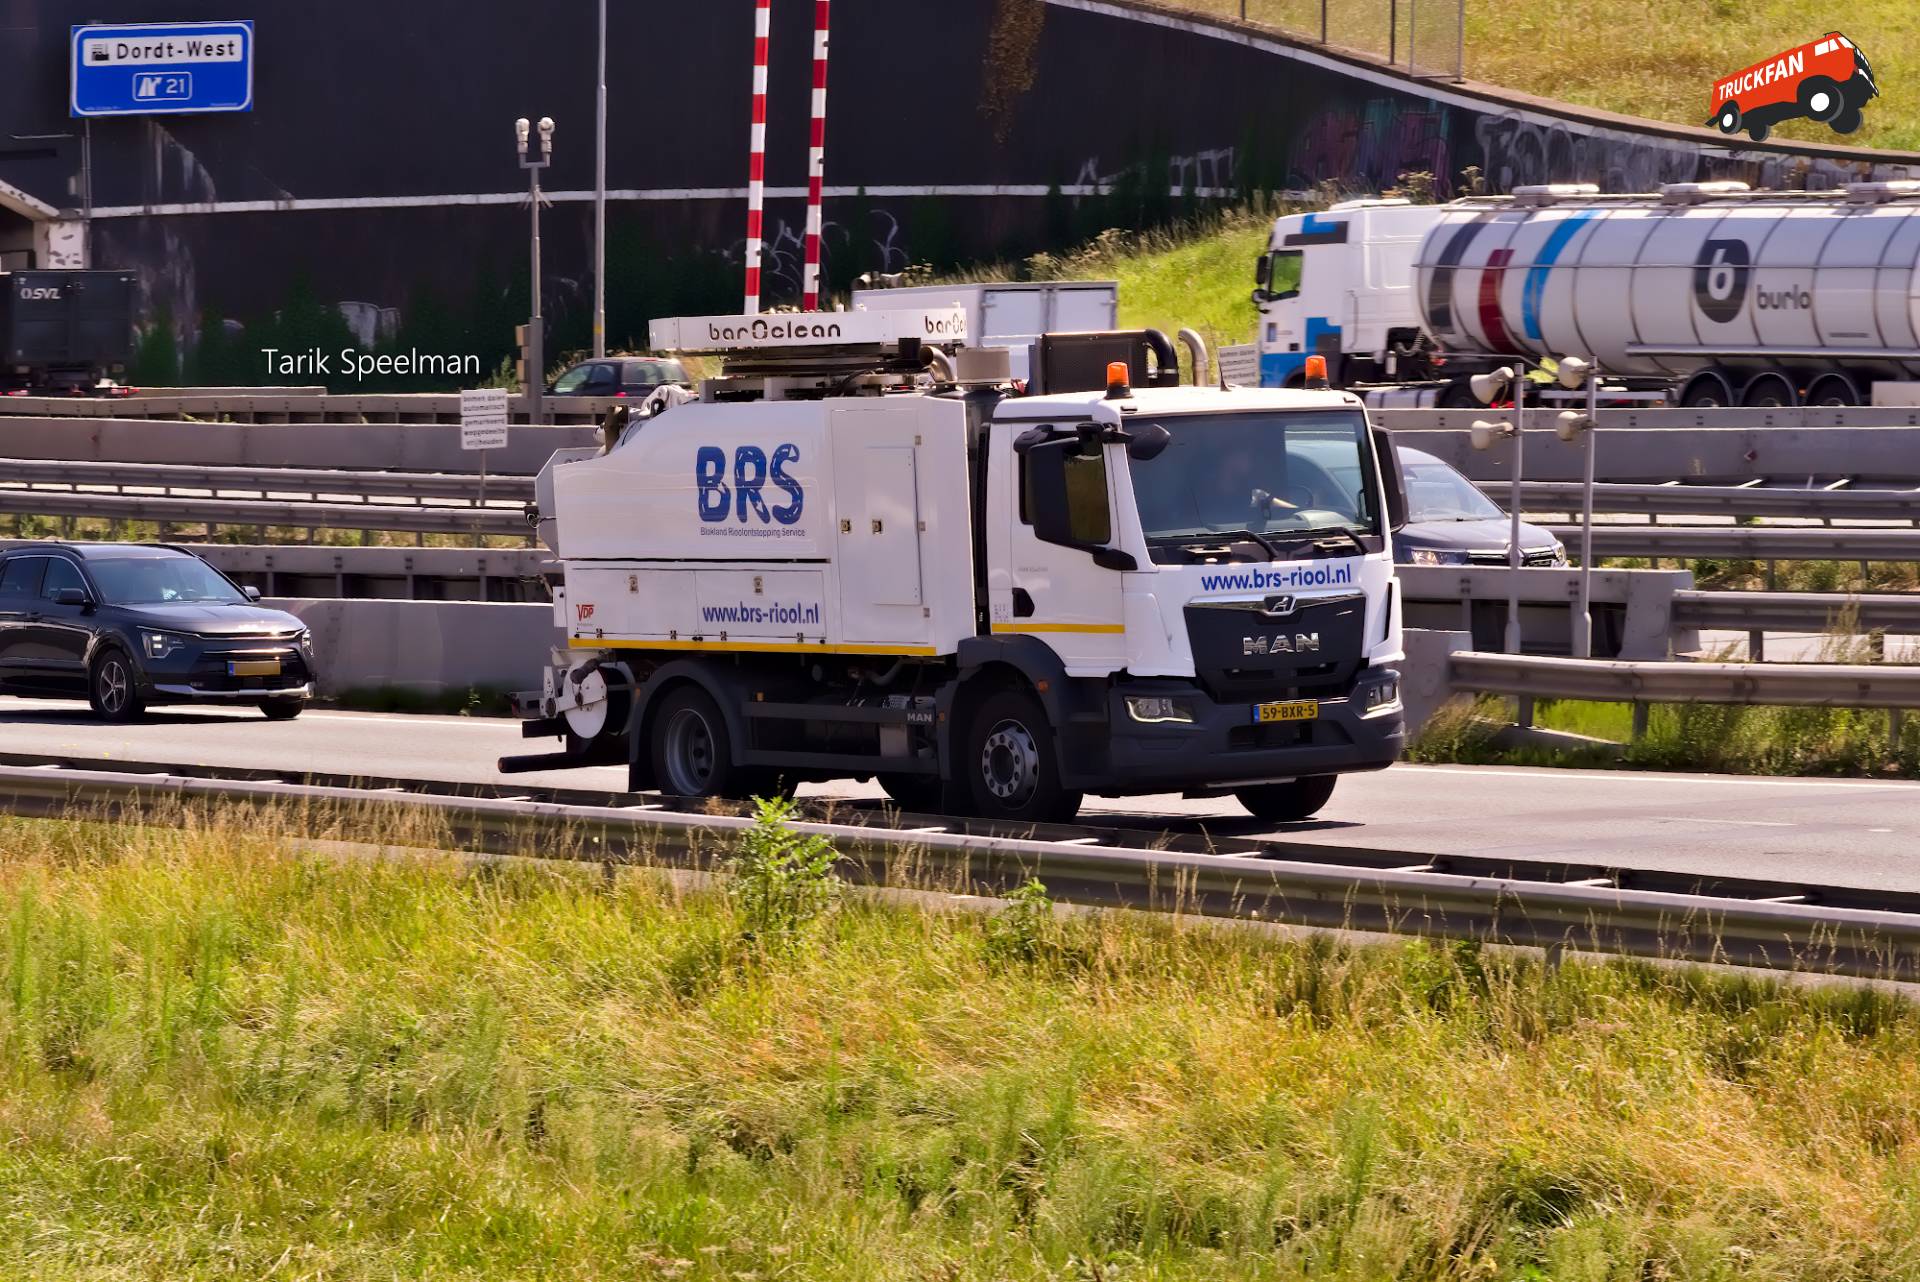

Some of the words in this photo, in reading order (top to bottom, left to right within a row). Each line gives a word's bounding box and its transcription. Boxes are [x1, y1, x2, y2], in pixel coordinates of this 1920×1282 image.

[116, 40, 236, 60] Dordt-West
[165, 78, 185, 94] 21
[1756, 284, 1812, 310] burlo
[696, 443, 804, 525] BRS
[781, 527, 806, 537] Service
[1201, 563, 1352, 591] www.brs-riool.nl
[576, 604, 595, 622] VDP
[702, 601, 819, 625] www.brs-riool.nl
[1243, 632, 1320, 656] MAN
[907, 712, 933, 722] MAN
[1262, 704, 1315, 720] 59-BXR-5
